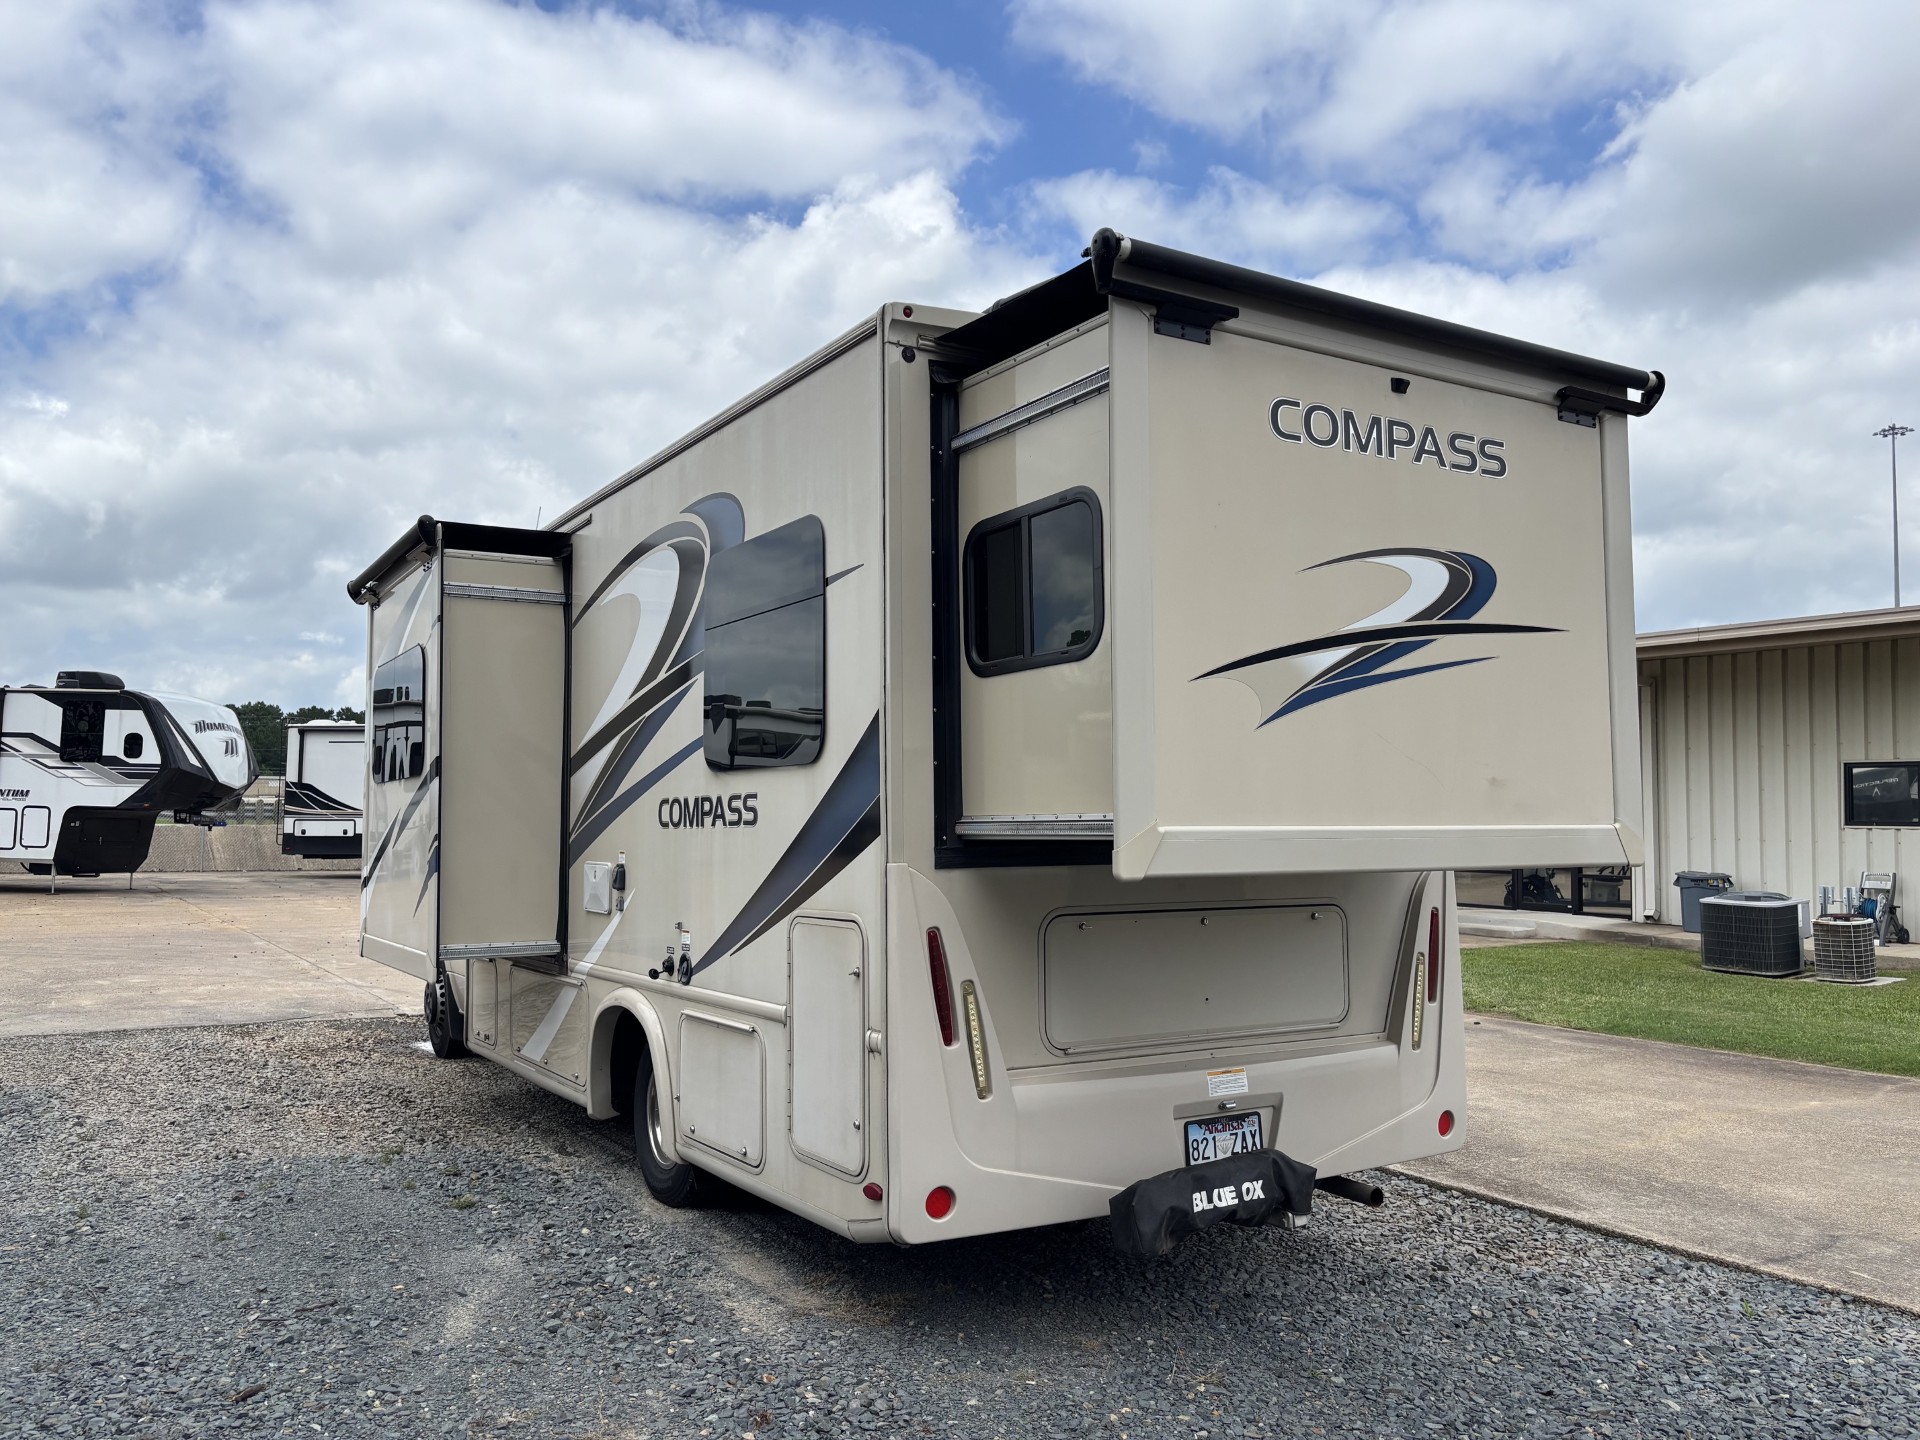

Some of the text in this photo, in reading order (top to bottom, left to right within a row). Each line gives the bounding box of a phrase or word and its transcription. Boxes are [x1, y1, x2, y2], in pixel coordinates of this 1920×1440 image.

[1267, 396, 1508, 479] COMPASS
[658, 792, 759, 830] COMPASS
[1203, 1120, 1245, 1135] Arkansas
[1191, 1129, 1259, 1161] 821 ZAX
[1192, 1179, 1265, 1213] BLUE OX
